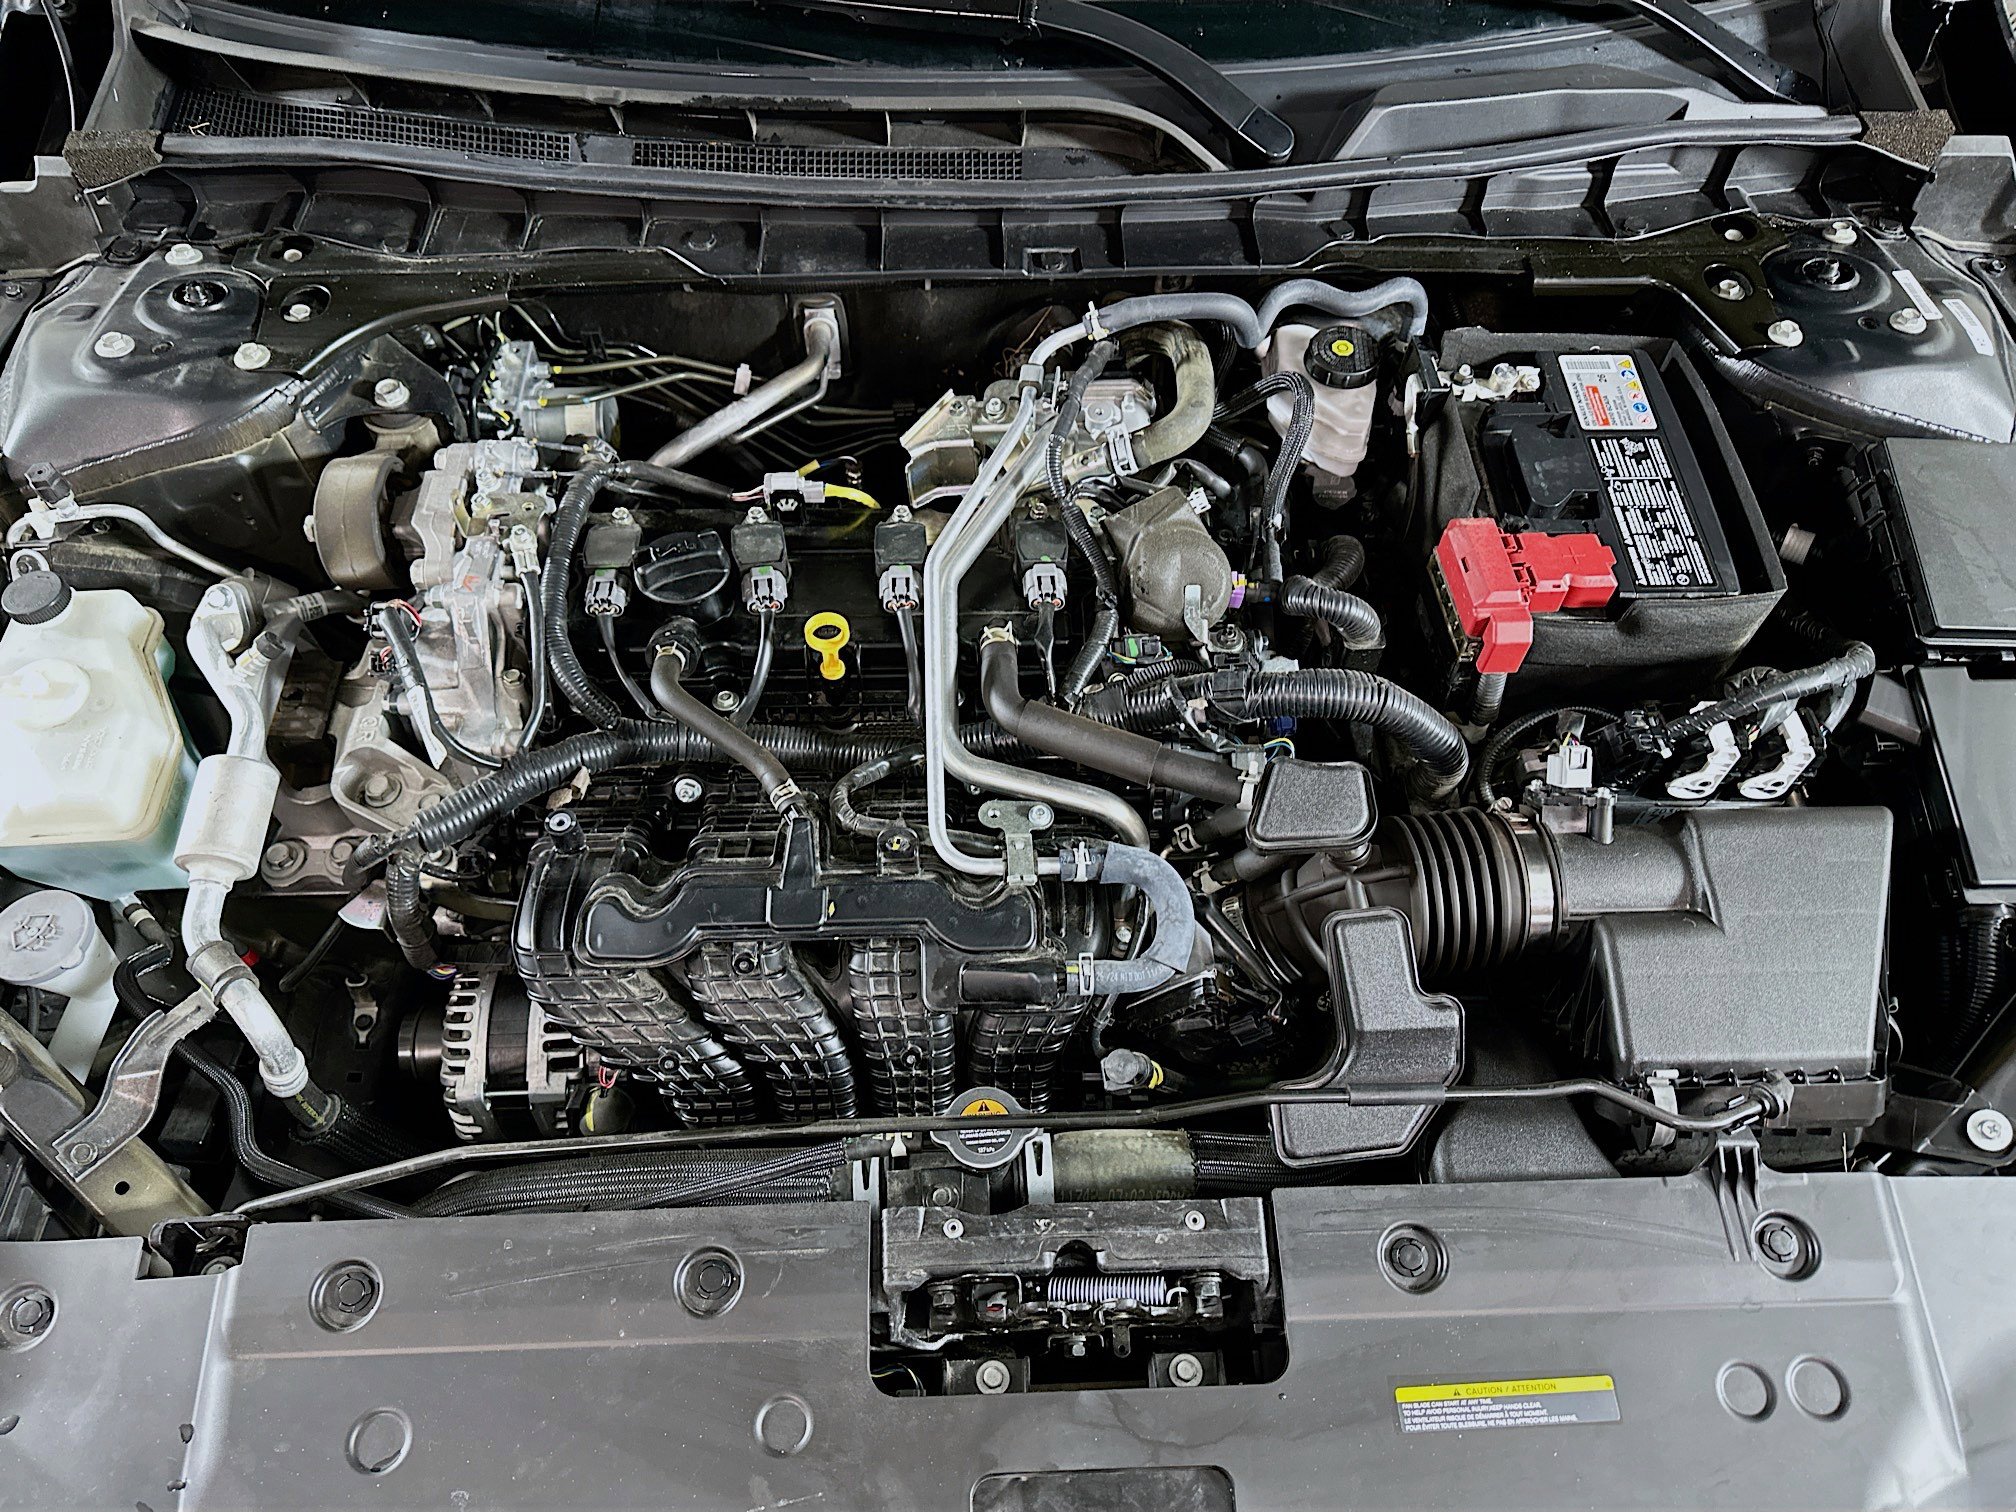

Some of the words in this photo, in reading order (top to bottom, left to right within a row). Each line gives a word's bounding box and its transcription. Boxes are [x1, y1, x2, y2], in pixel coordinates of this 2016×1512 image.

[1466, 1386, 1502, 1396] CAUTION
[1512, 1383, 1556, 1393] ATTENTION
[1412, 1408, 1425, 1416] HELP
[1426, 1407, 1442, 1415] AVOID
